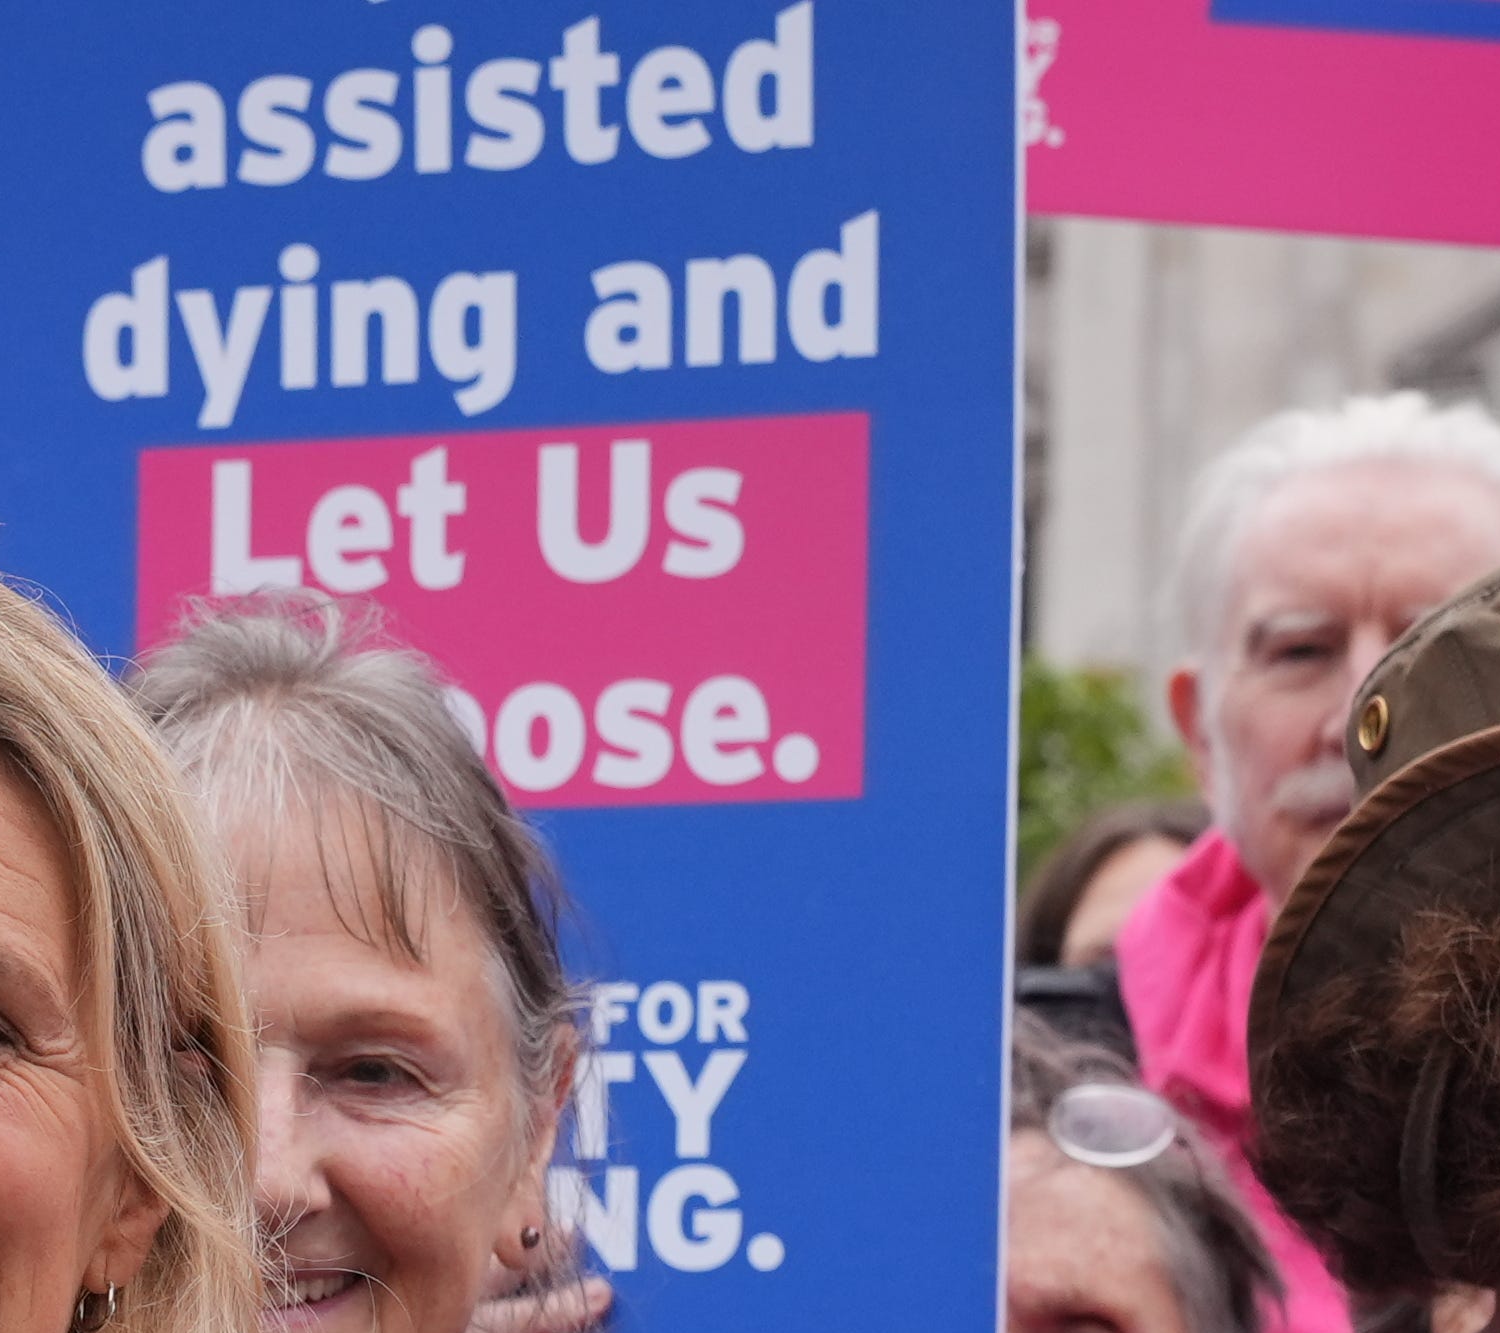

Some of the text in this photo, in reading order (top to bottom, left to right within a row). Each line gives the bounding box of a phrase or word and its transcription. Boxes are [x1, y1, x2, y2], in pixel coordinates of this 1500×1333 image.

[143, 5, 813, 192] assisted
[83, 211, 878, 428] dying and
[211, 440, 744, 598] Let Us
[592, 980, 749, 1044] FOR
